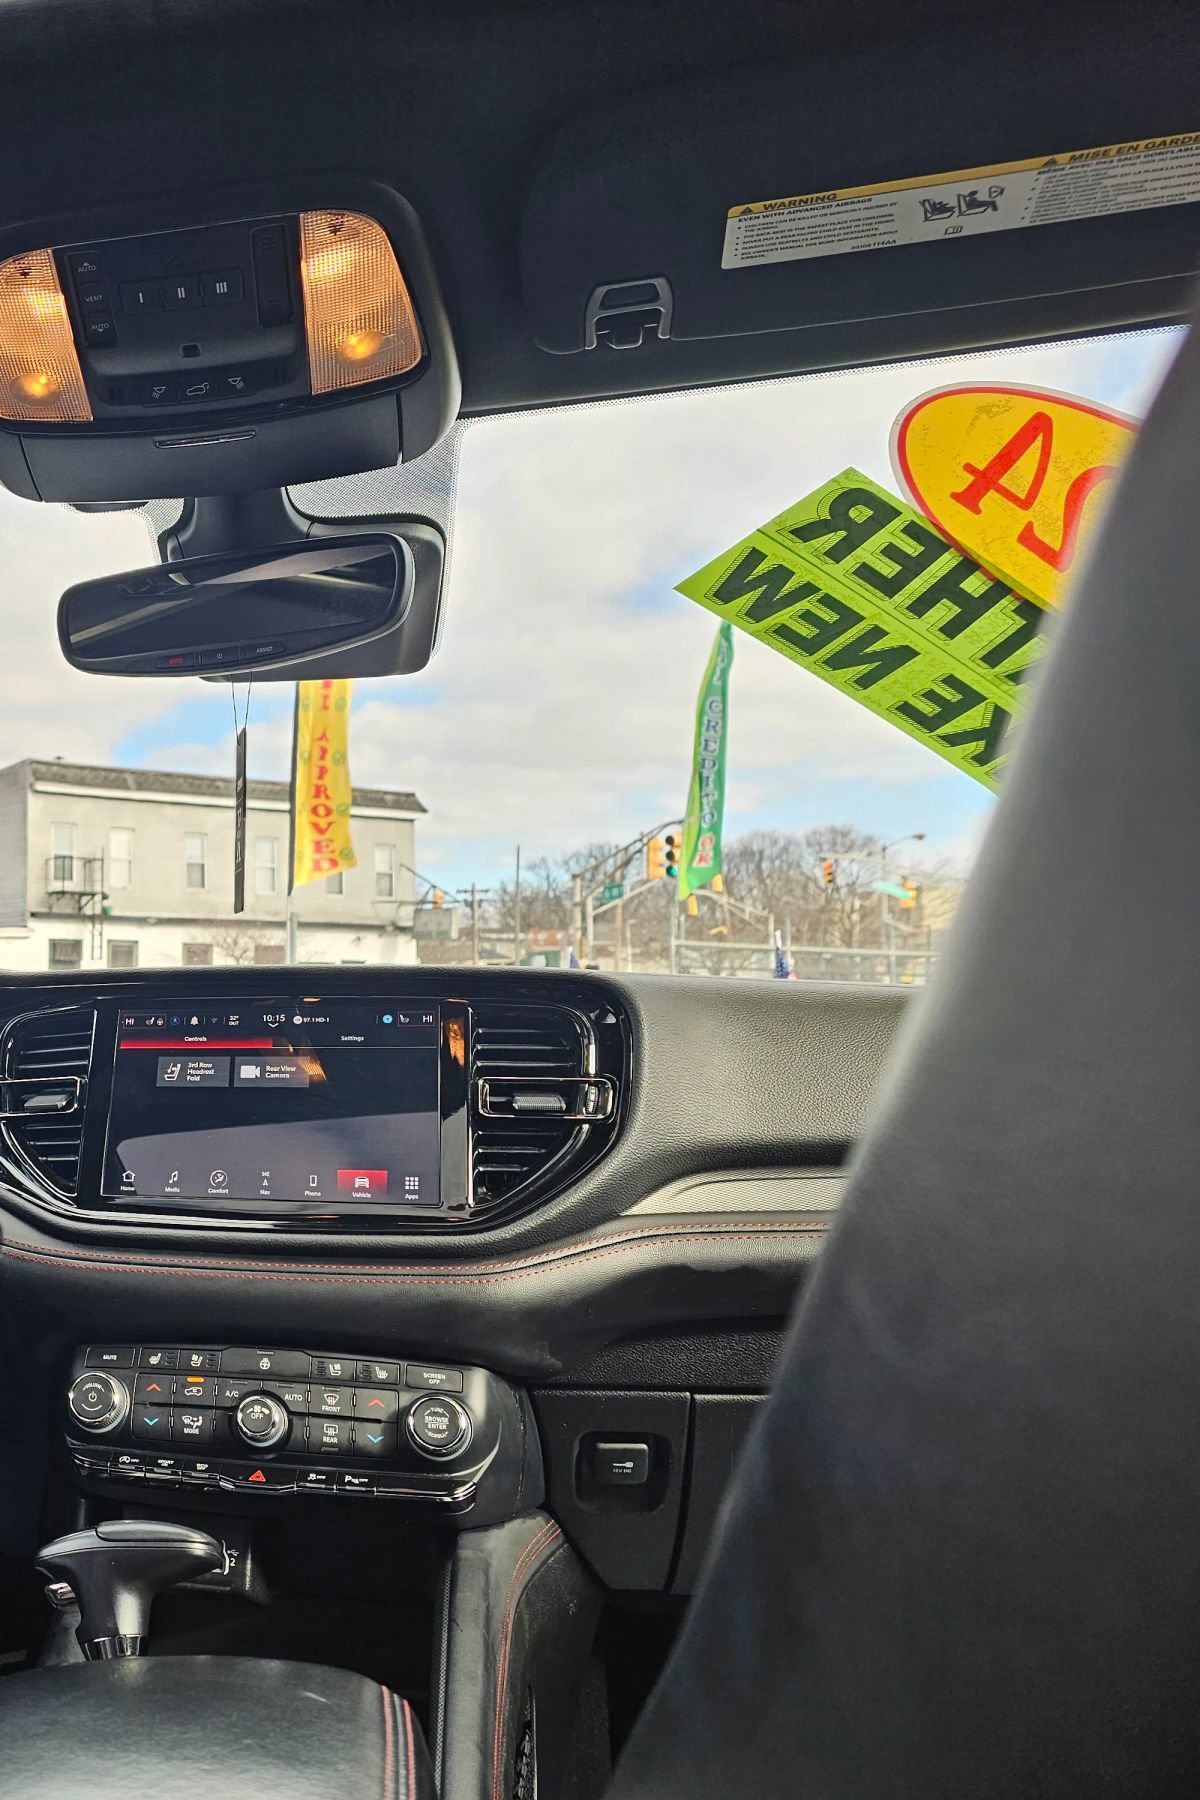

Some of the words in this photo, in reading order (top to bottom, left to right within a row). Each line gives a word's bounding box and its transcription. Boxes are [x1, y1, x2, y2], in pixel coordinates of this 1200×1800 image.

[1068, 150, 1113, 163] MISE
[1116, 144, 1140, 155] EN
[763, 193, 838, 210] WARNING
[786, 205, 832, 214] ADVANCED
[835, 198, 872, 208] AIRBAGS
[699, 698, 724, 828] CREDITO
[310, 730, 338, 872] APPROVED
[693, 832, 715, 868] OK
[263, 1014, 285, 1022] 10:15
[423, 1015, 433, 1023] HI
[230, 1558, 235, 1566] 2
